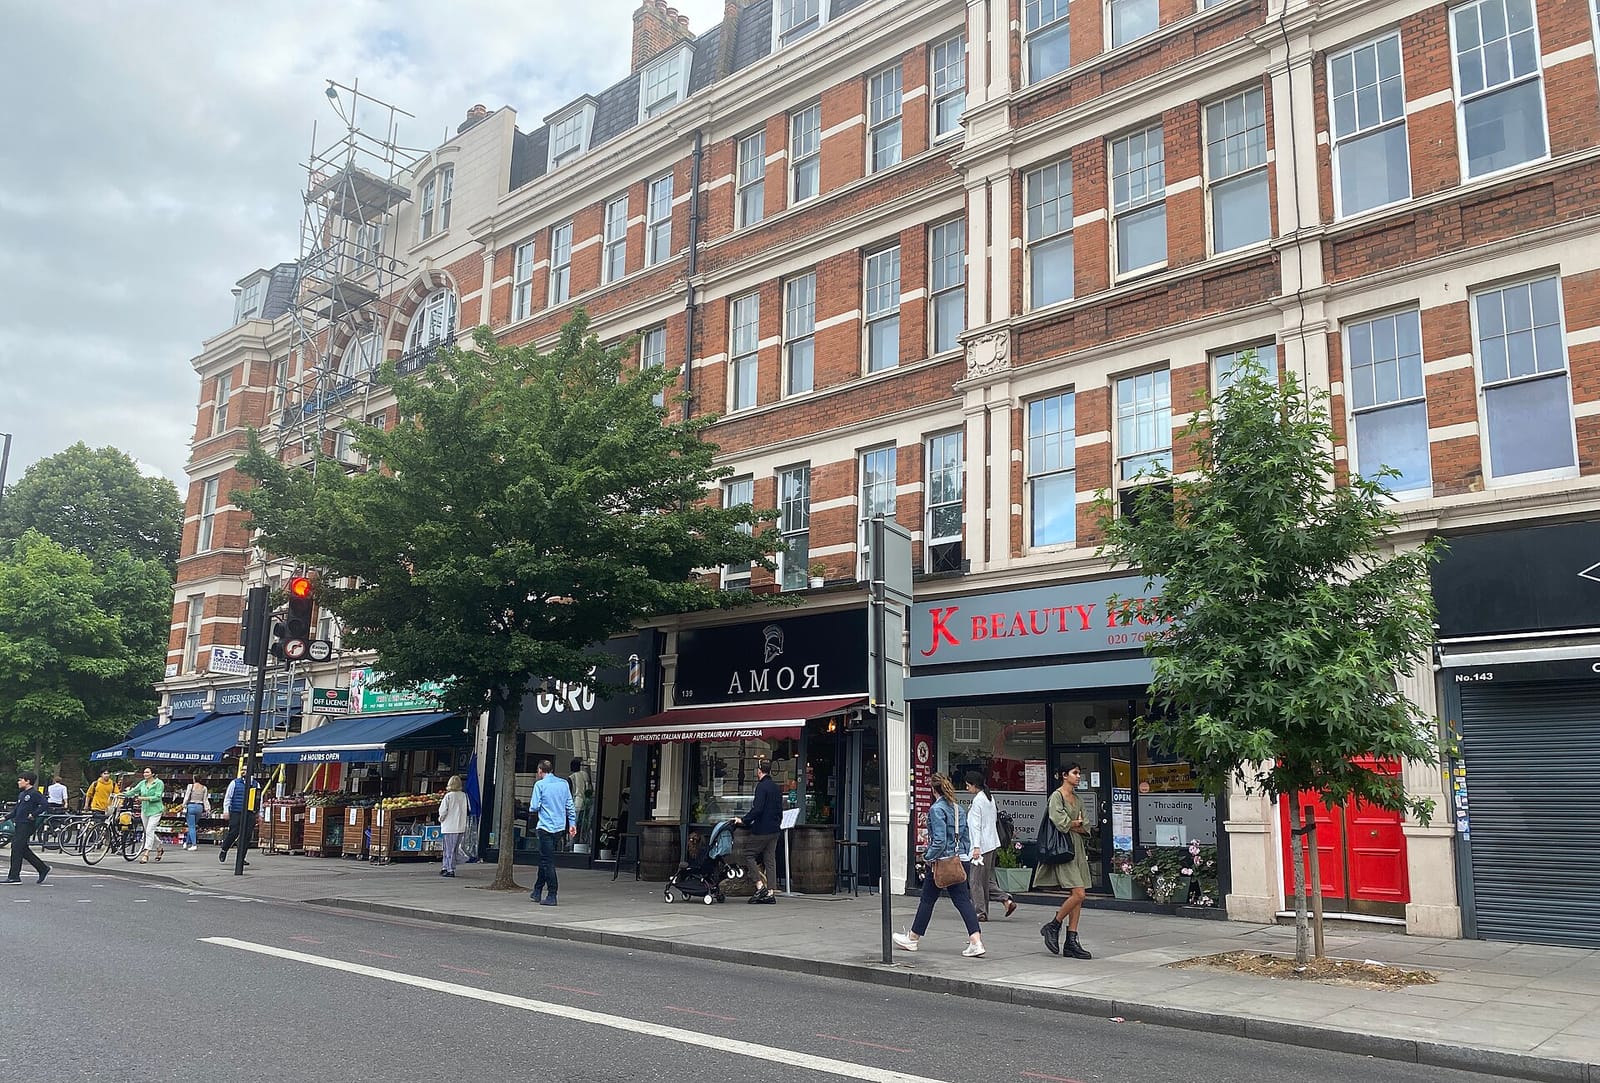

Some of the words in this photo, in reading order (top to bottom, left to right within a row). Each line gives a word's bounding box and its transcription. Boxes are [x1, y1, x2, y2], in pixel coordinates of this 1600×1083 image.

[970, 603, 1097, 641] BEAUTY
[1105, 597, 1175, 627] HU
[1107, 634, 1128, 645] 020
[1455, 672, 1493, 682] No.143
[682, 690, 693, 698] 139
[173, 698, 206, 710] MOONLIGHT
[697, 731, 733, 739] RESTAURANT
[325, 752, 340, 760] OPEN
[1113, 793, 1132, 801] OPEN
[1002, 799, 1038, 807] Manicure
[1154, 801, 1193, 811] Threading
[1006, 811, 1035, 819] edicure
[1154, 815, 1183, 825] Waxing
